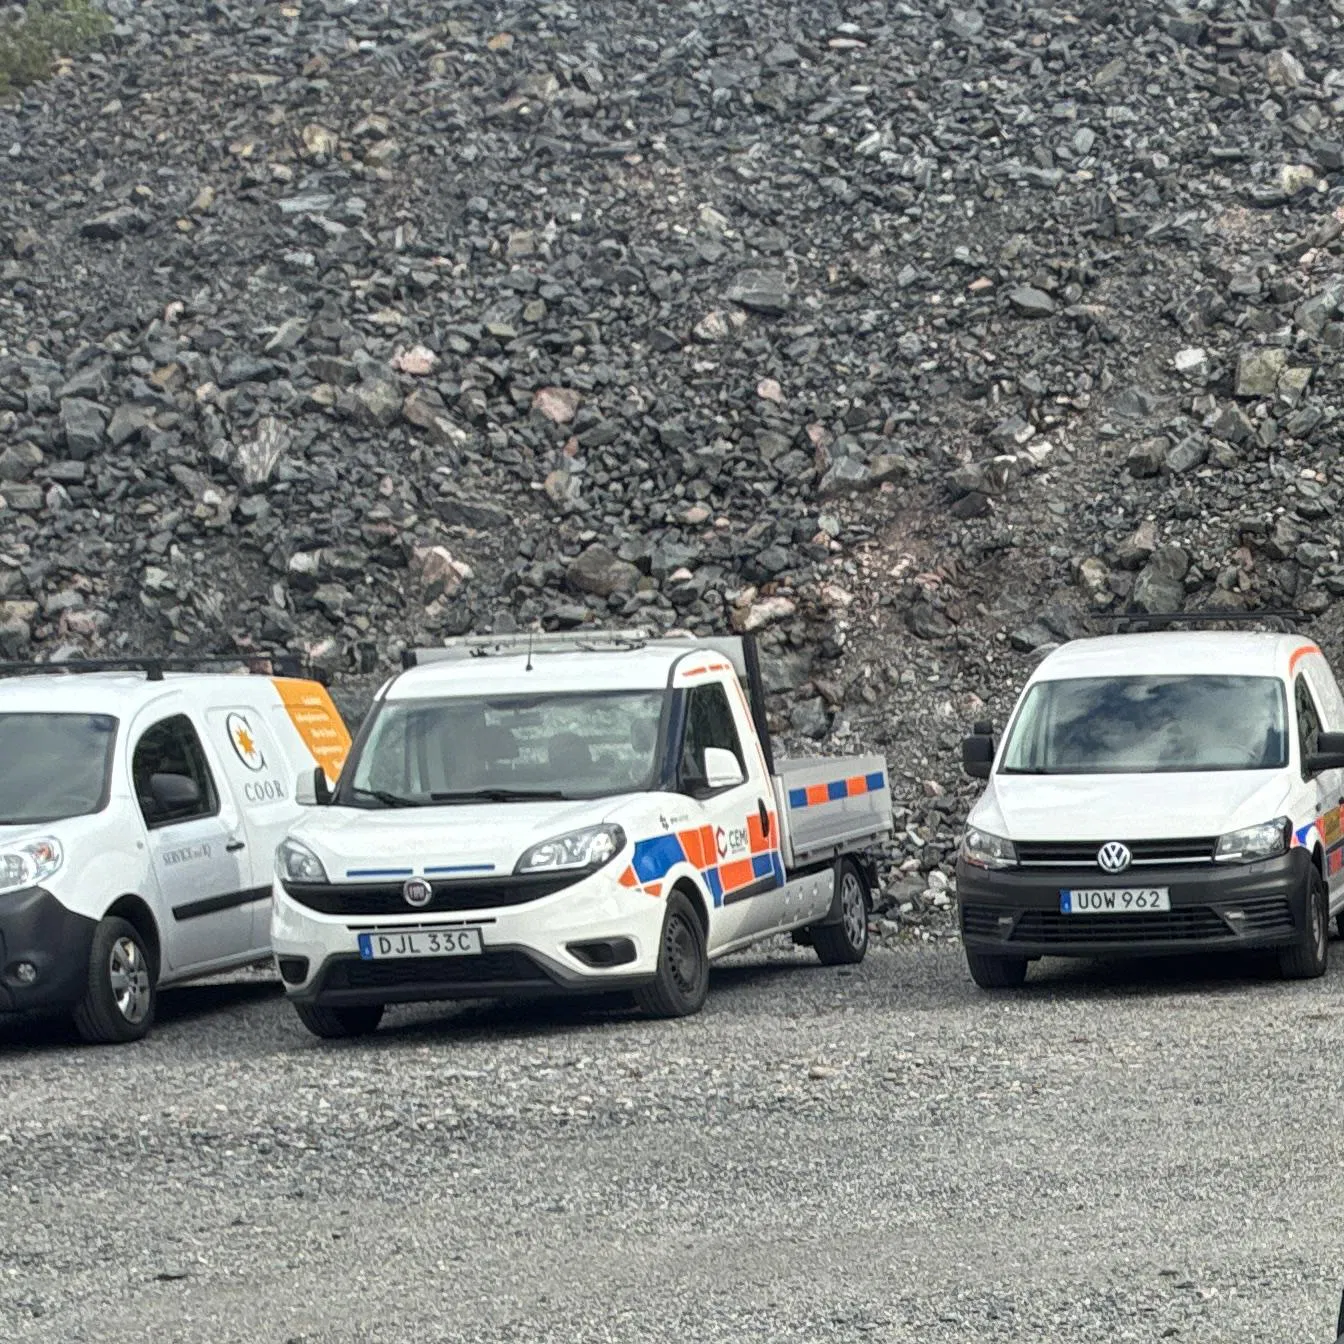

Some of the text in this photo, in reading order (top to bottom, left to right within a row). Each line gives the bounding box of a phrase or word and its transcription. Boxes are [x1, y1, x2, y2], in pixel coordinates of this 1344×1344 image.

[244, 779, 284, 802] COOR
[1077, 890, 1160, 910] UOW 962
[378, 932, 471, 955] DJL 33C
